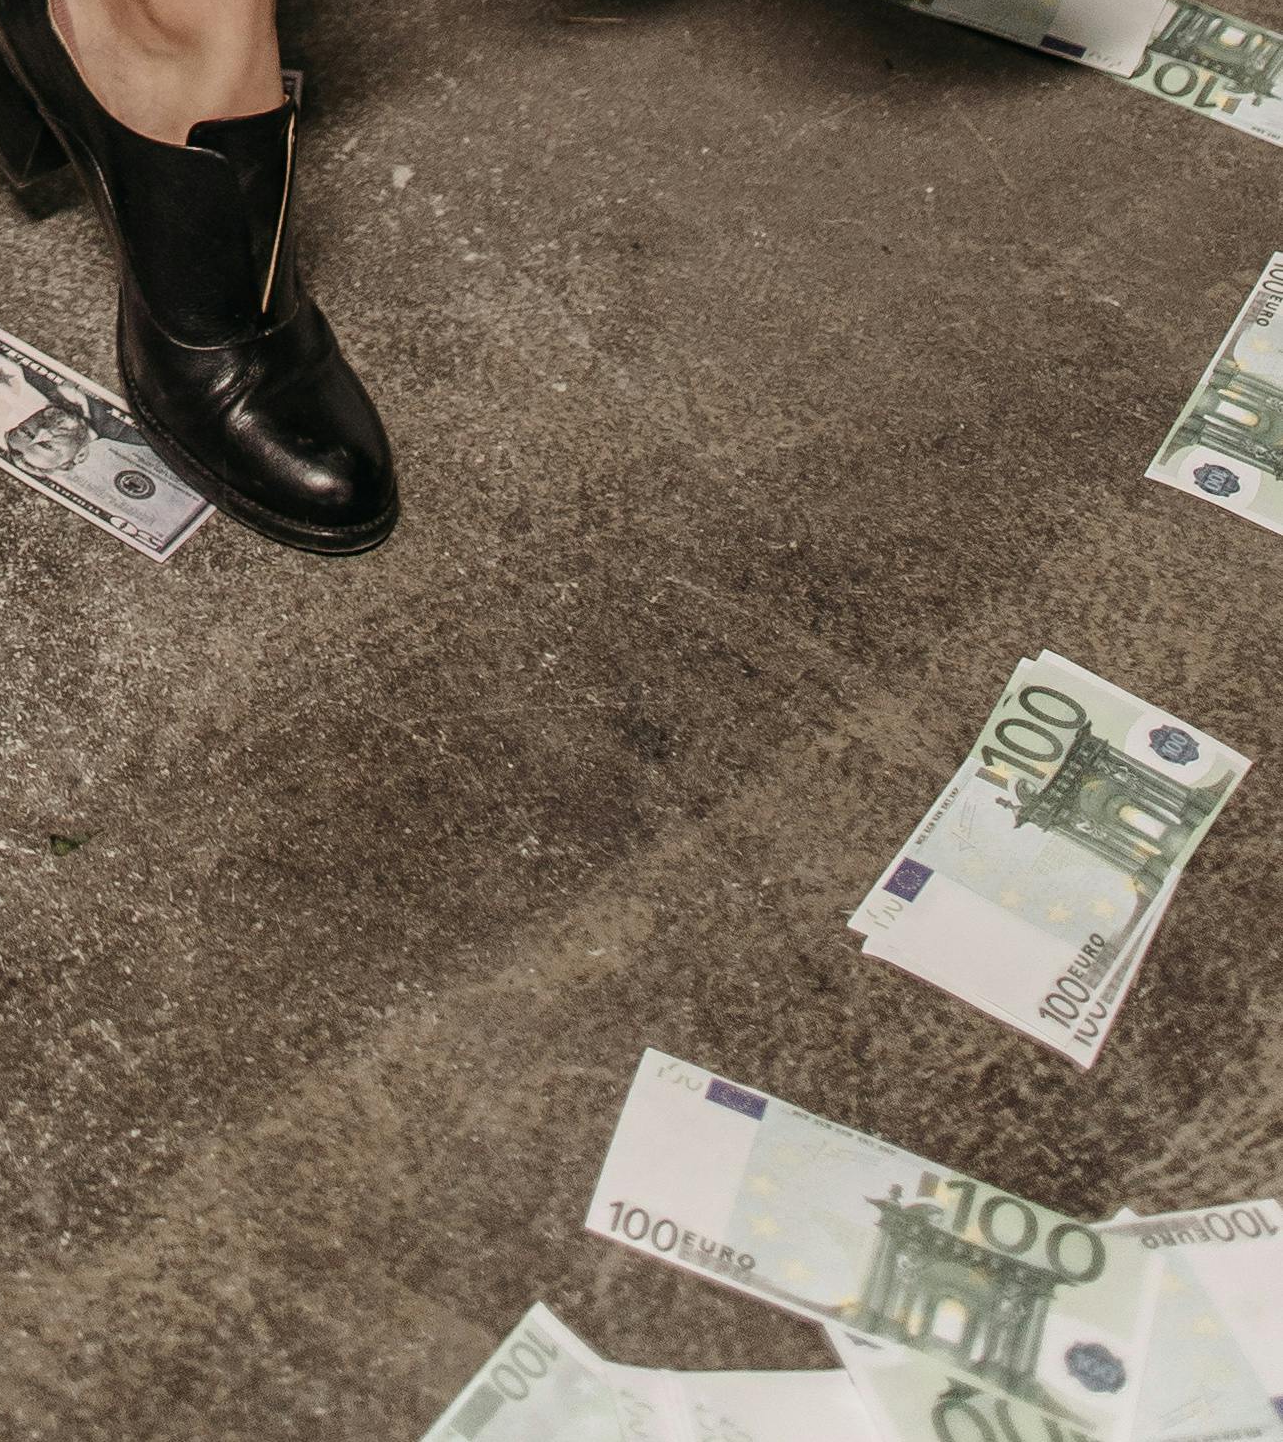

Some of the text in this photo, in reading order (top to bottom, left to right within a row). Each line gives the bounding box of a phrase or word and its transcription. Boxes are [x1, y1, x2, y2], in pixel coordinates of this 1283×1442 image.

[980, 684, 1088, 780] 100
[1039, 932, 1106, 1029] 100 EURO
[608, 1200, 757, 1271] 100 EURO
[945, 1179, 1107, 1288] 100
[1141, 1206, 1280, 1250] 100 EURO
[491, 1328, 560, 1402] 100
